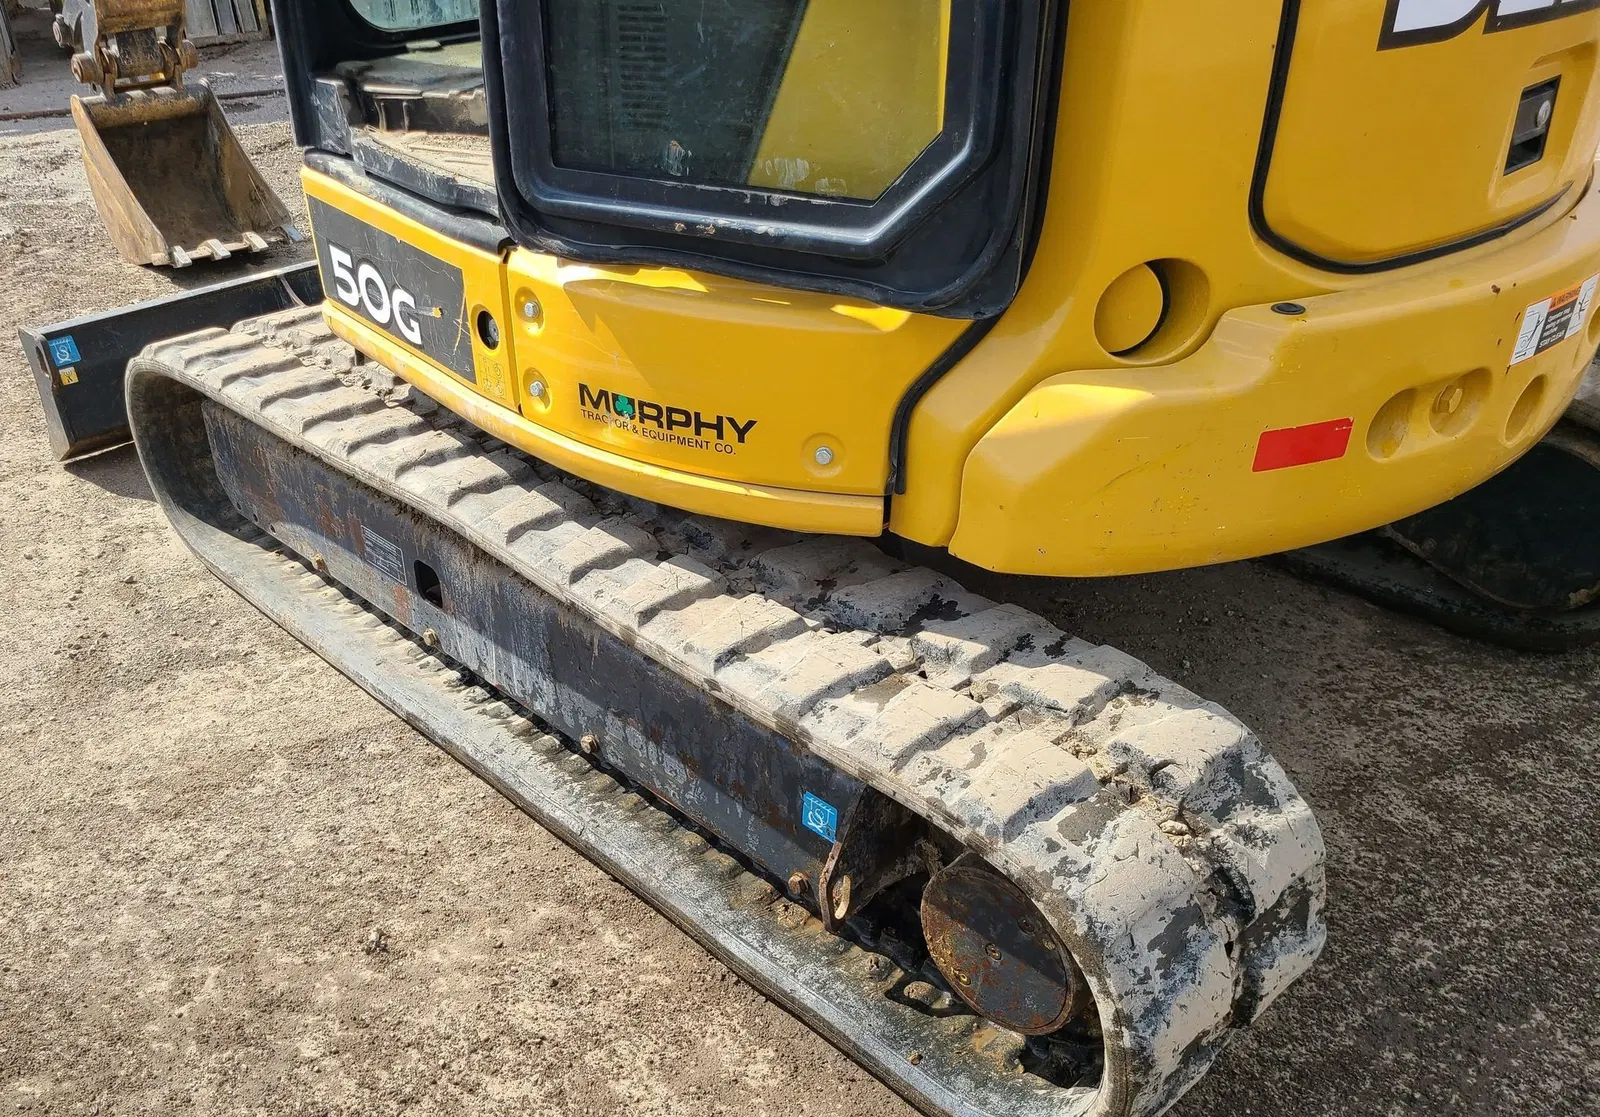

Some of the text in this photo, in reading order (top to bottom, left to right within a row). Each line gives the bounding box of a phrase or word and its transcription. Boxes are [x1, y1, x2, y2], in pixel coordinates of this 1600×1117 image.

[328, 244, 422, 345] 50G
[578, 382, 758, 444] MURPHY
[631, 426, 640, 435] &
[641, 427, 711, 450] EQUIPMENT
[714, 442, 736, 455] CO.
